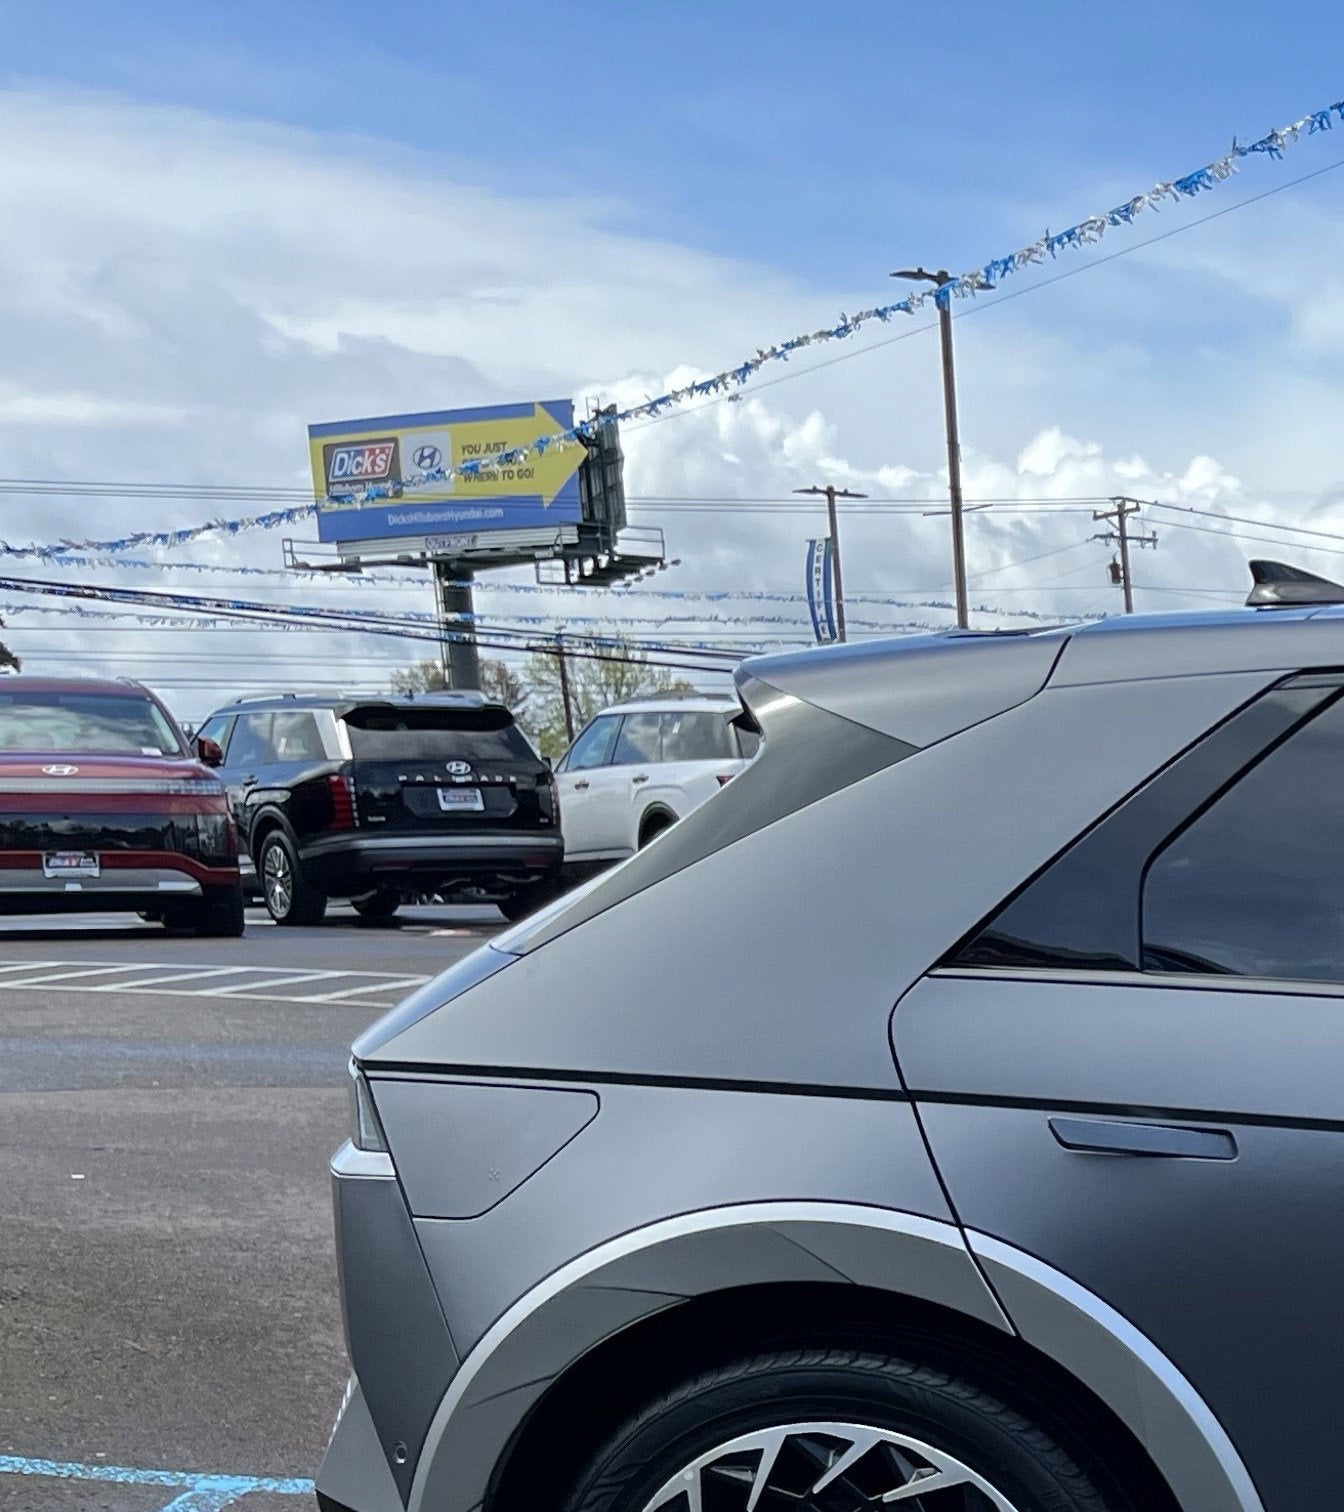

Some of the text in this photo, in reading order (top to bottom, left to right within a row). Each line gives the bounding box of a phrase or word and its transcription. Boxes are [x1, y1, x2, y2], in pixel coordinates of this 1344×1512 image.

[462, 441, 507, 455] YOU JUST
[333, 448, 387, 476] Dick's
[501, 468, 514, 480] TO
[814, 543, 828, 642] CERTIFIE
